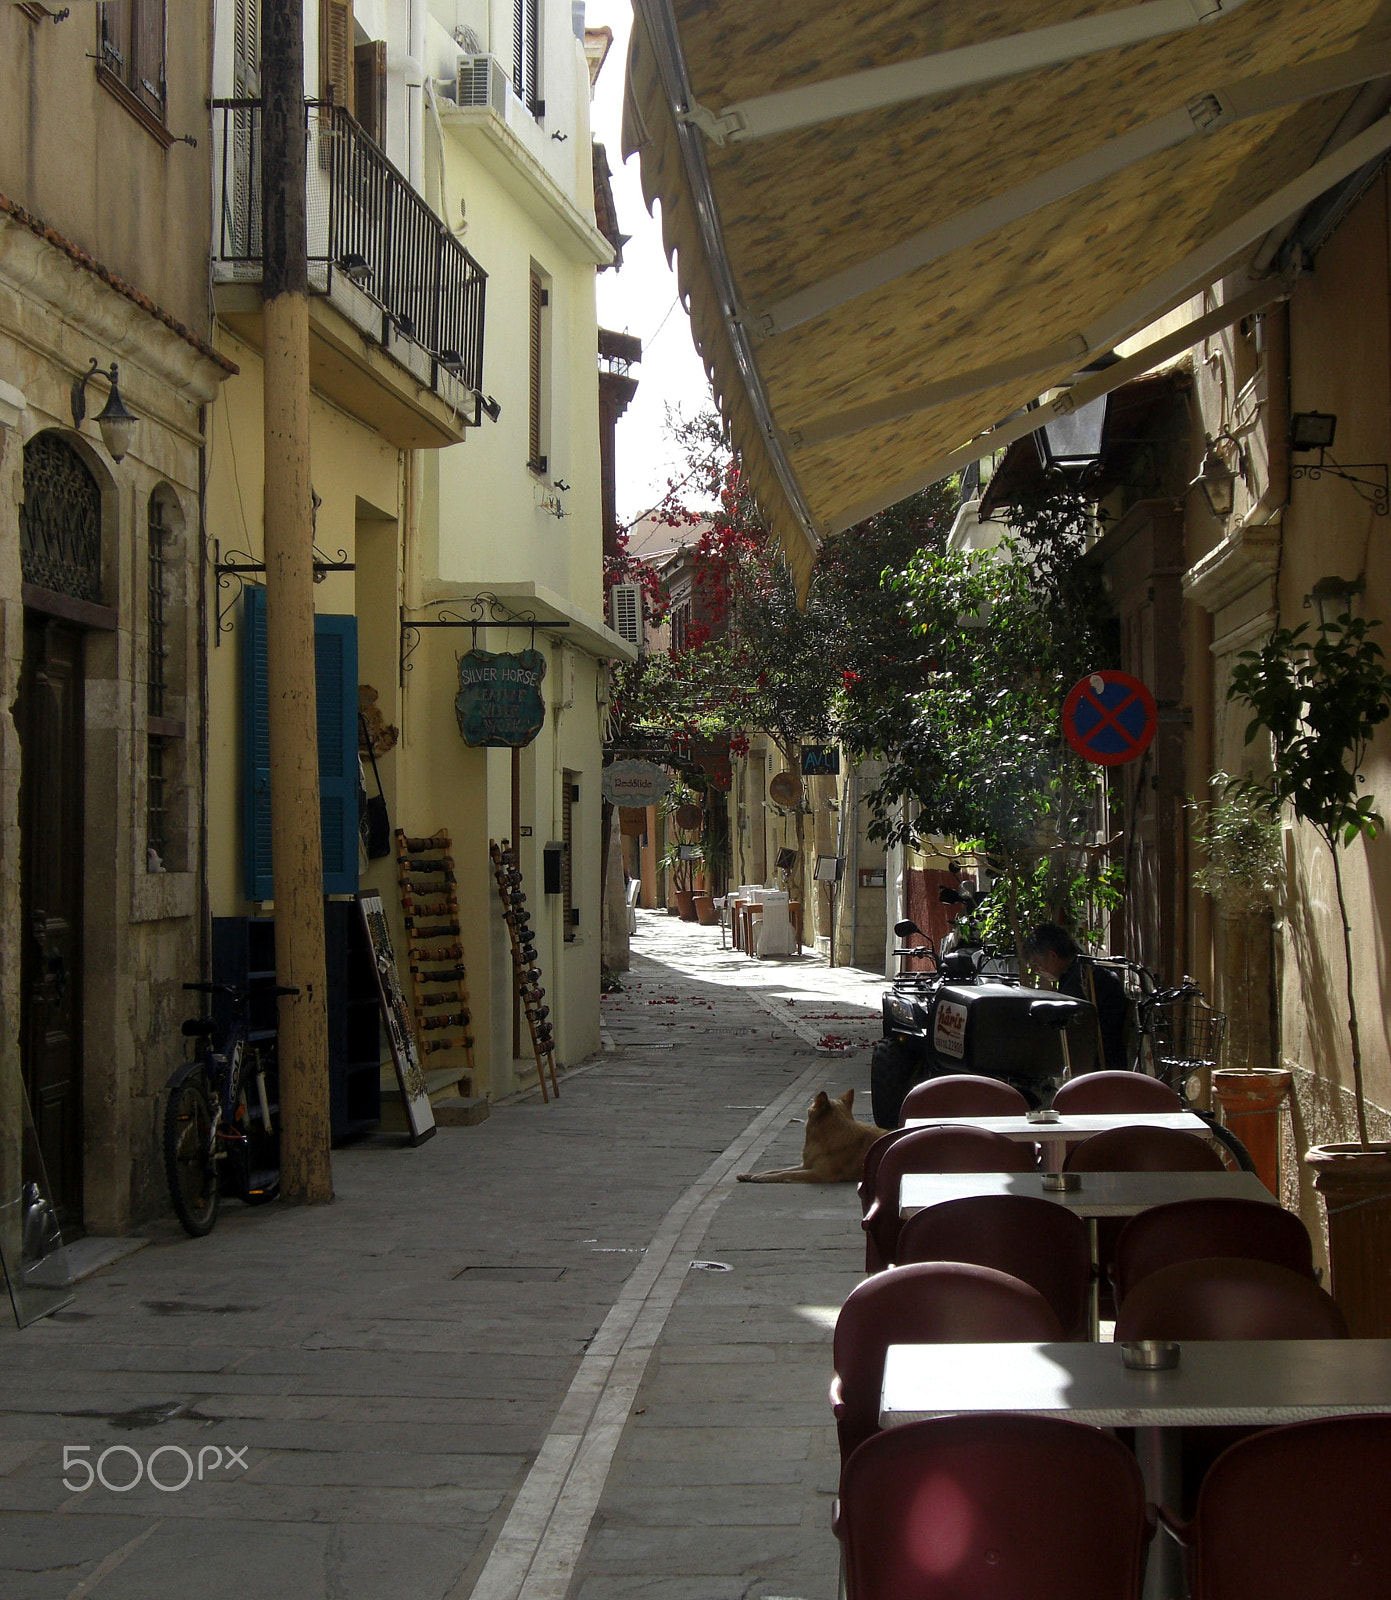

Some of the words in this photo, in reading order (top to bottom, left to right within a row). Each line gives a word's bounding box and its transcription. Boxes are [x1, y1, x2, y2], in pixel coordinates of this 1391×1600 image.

[461, 667, 497, 685] SILVER
[502, 668, 538, 687] HORSE
[804, 751, 836, 769] AVLI
